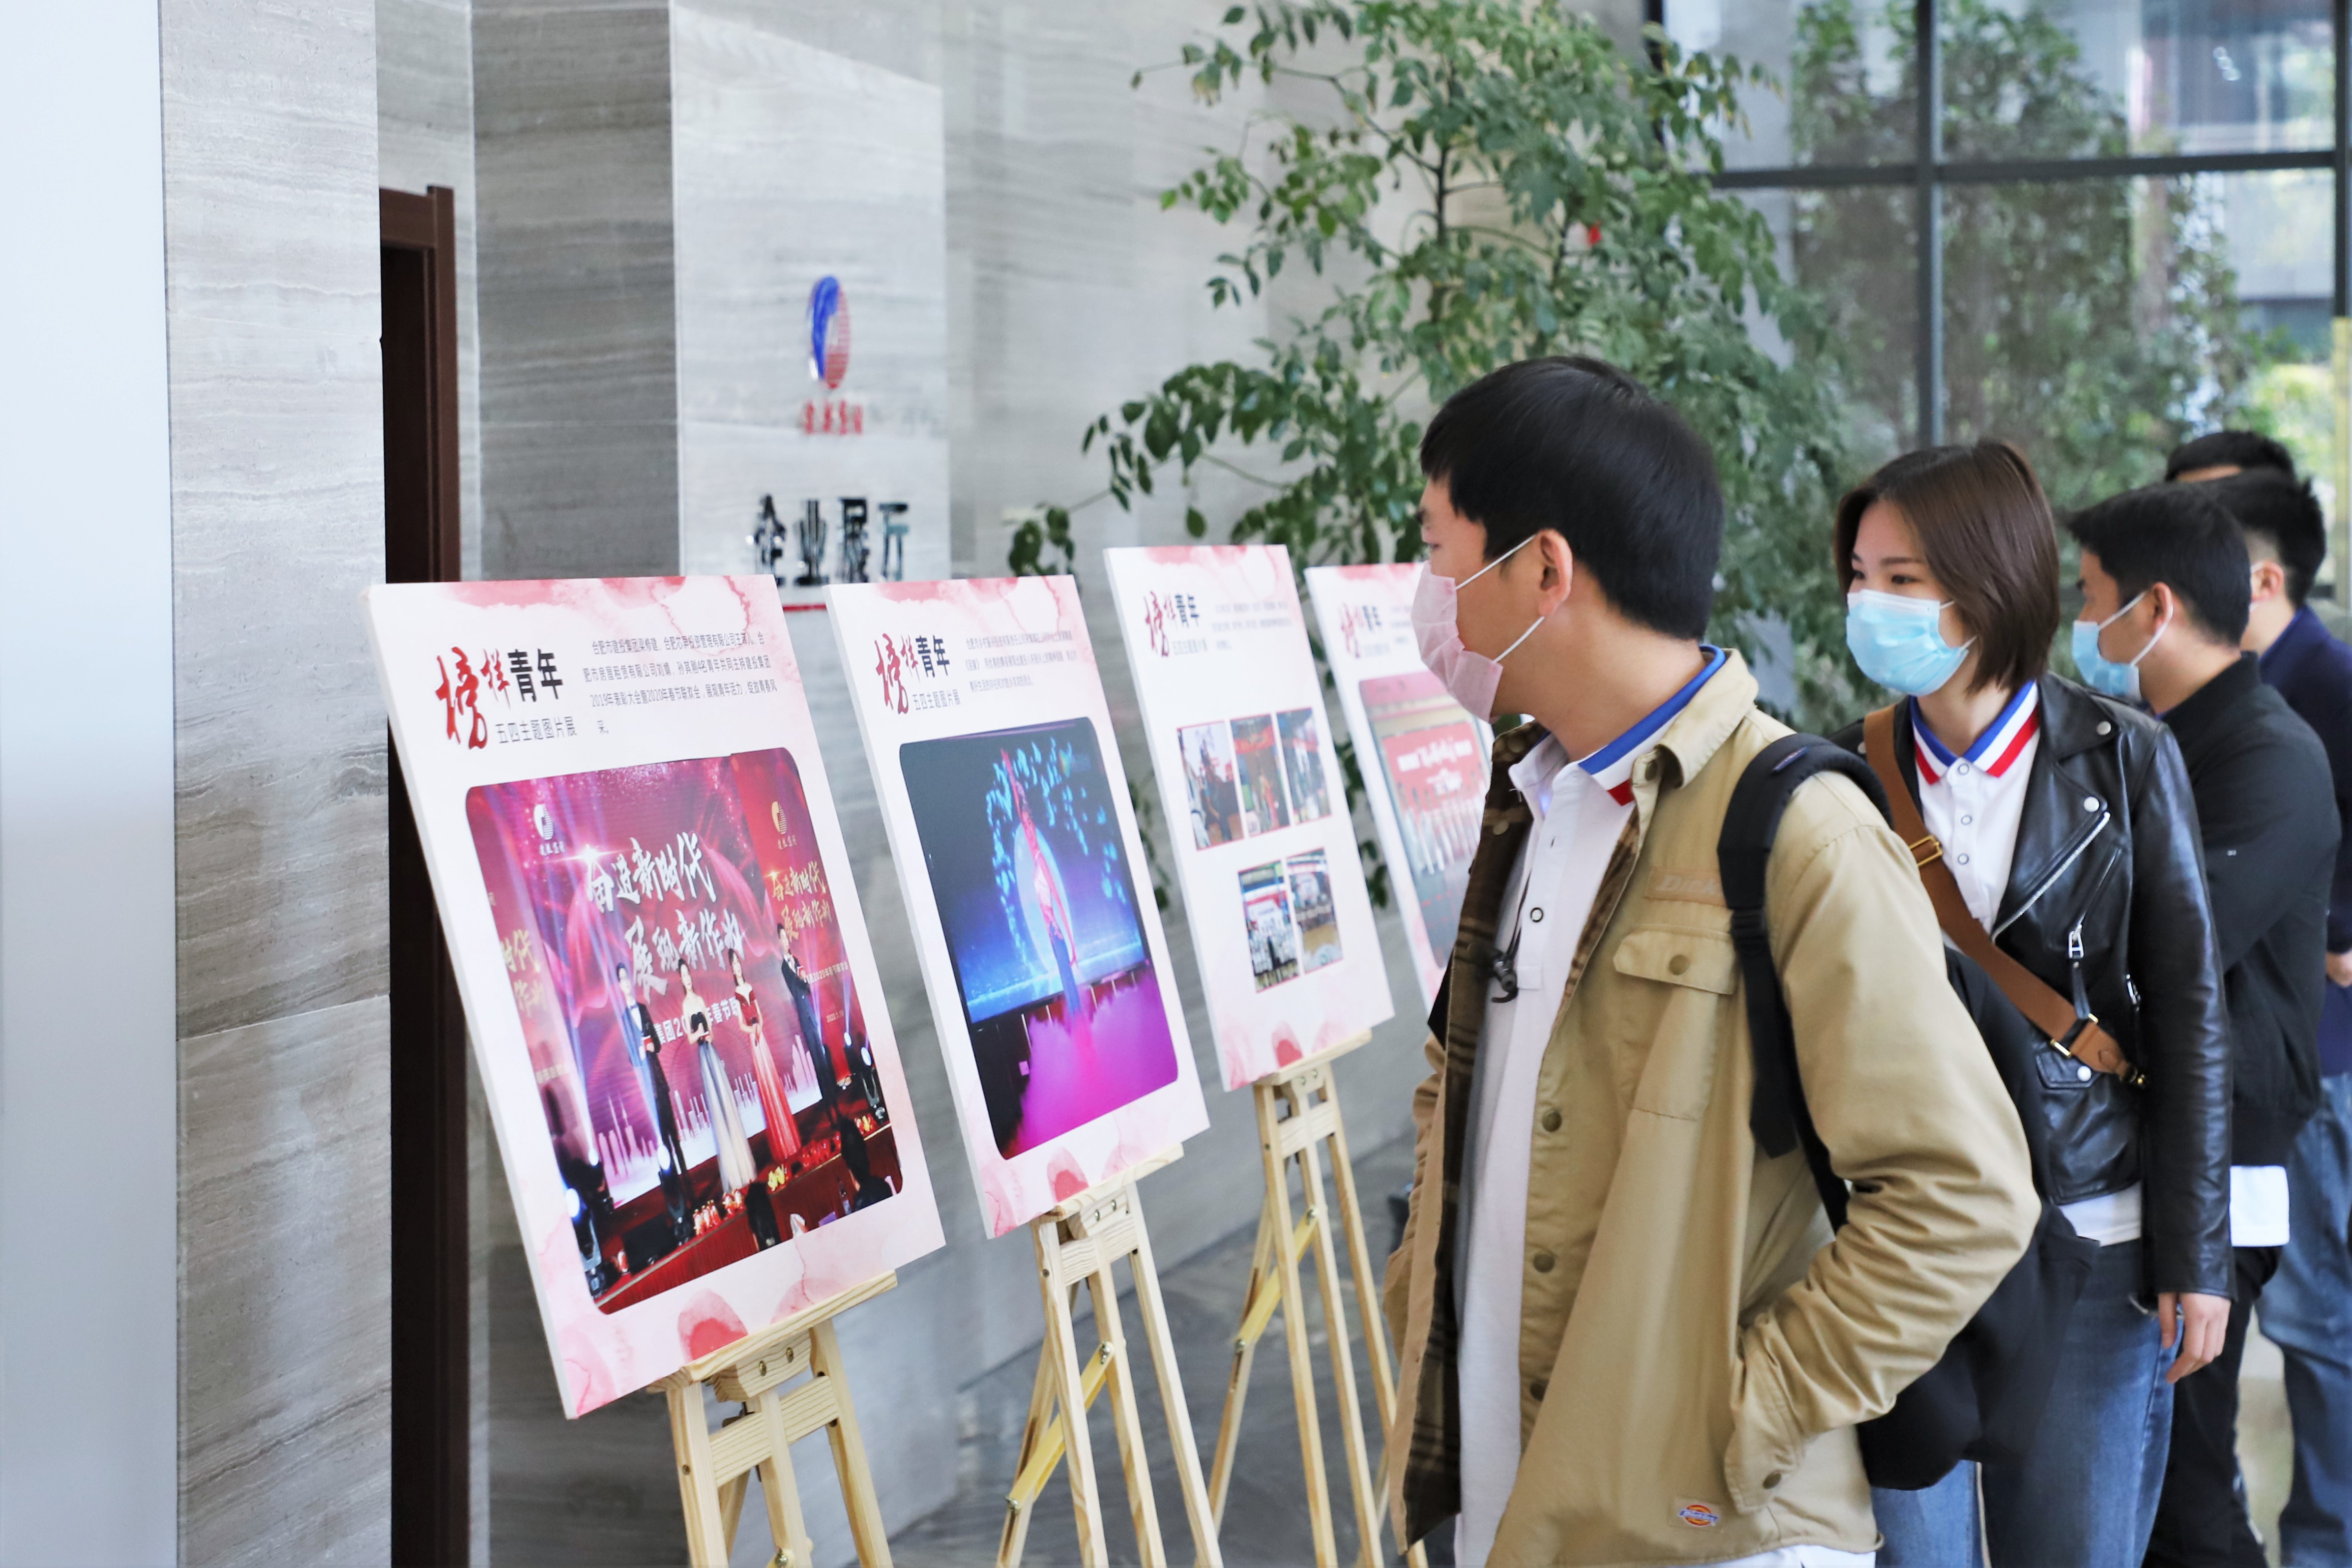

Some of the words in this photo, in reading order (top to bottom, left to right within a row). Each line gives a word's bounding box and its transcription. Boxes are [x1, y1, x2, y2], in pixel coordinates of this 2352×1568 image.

[435, 646, 563, 750] 榜样青年
[874, 633, 950, 714] 榜样青年
[912, 689, 961, 710] 五四主题图片展
[495, 716, 577, 743] 五四主题图片展
